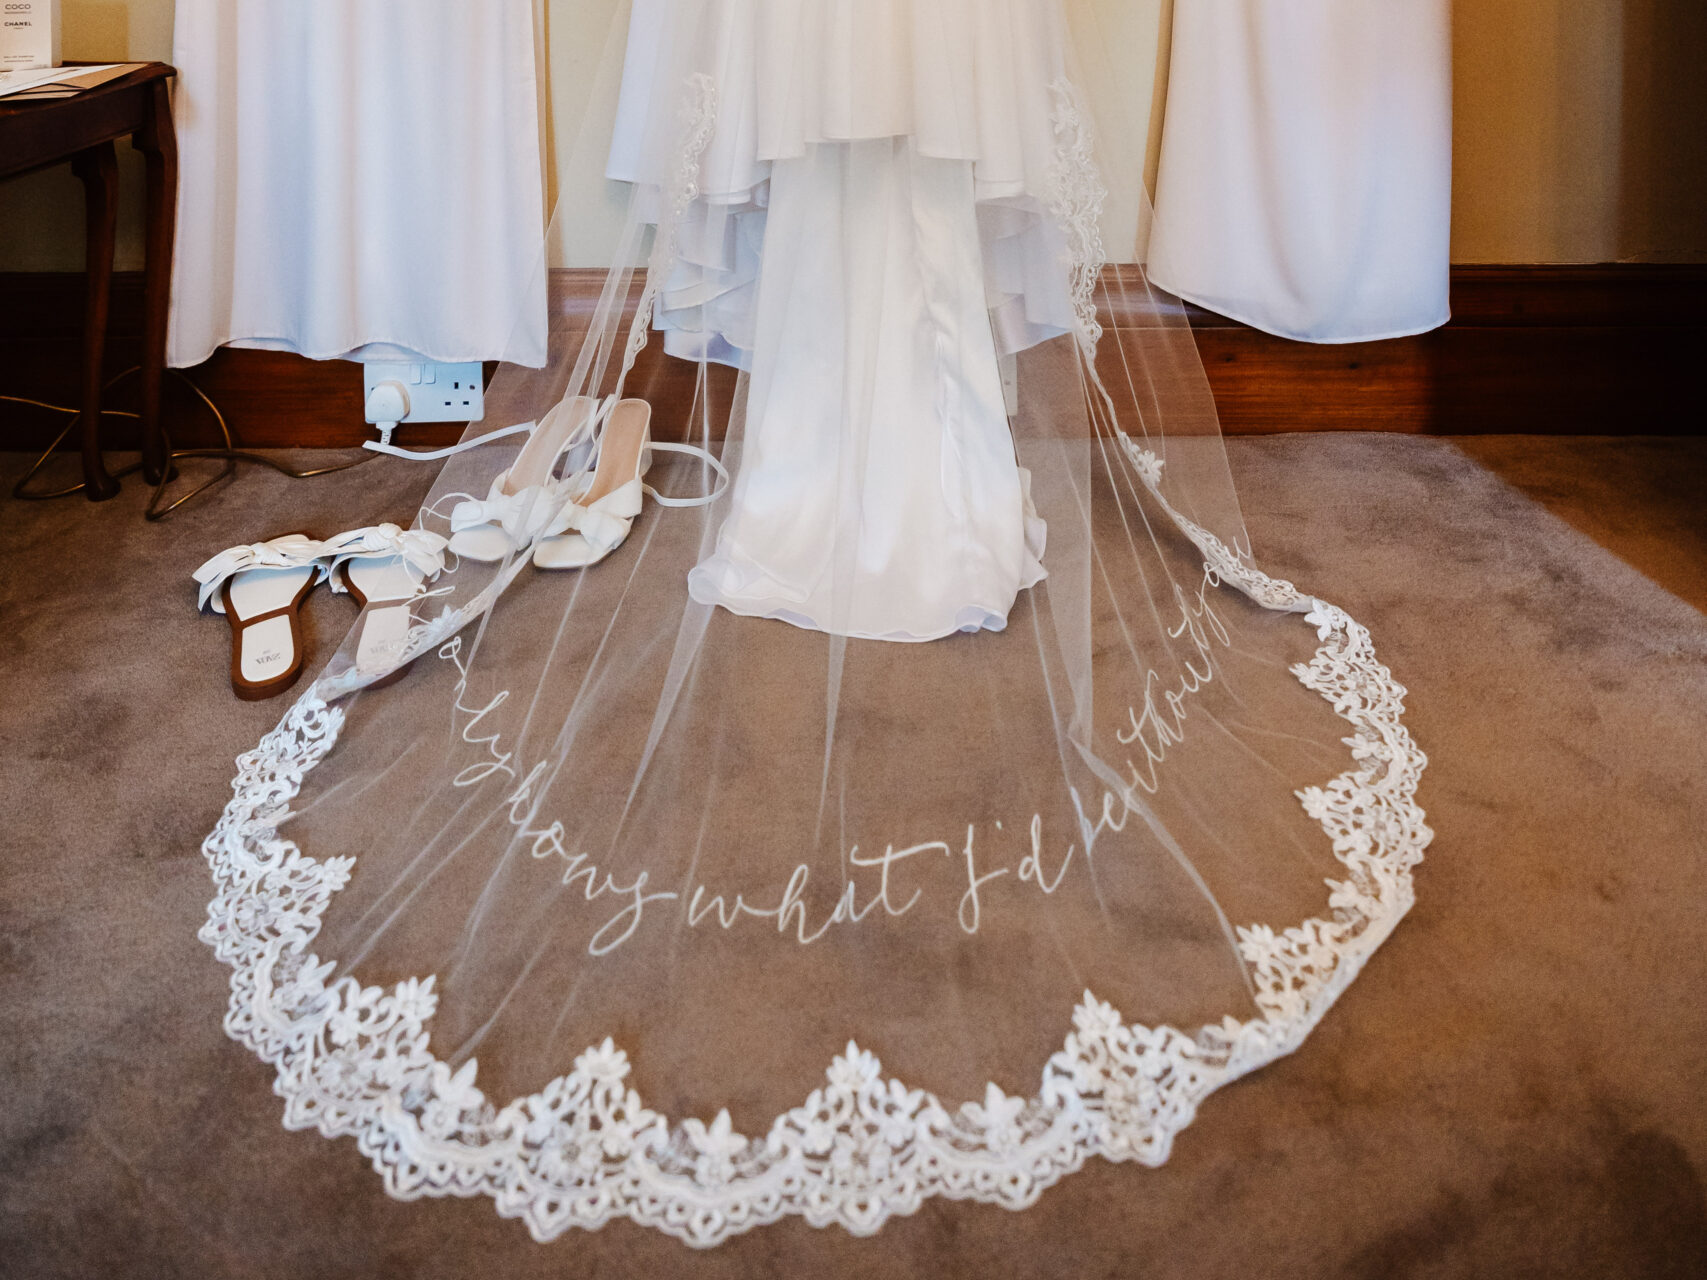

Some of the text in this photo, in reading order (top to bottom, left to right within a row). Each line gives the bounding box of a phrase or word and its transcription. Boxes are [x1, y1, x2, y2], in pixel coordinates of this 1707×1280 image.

[509, 759, 678, 956] kows
[688, 841, 949, 945] what
[957, 813, 1074, 934] I'd
[1116, 583, 1213, 794] ithout
